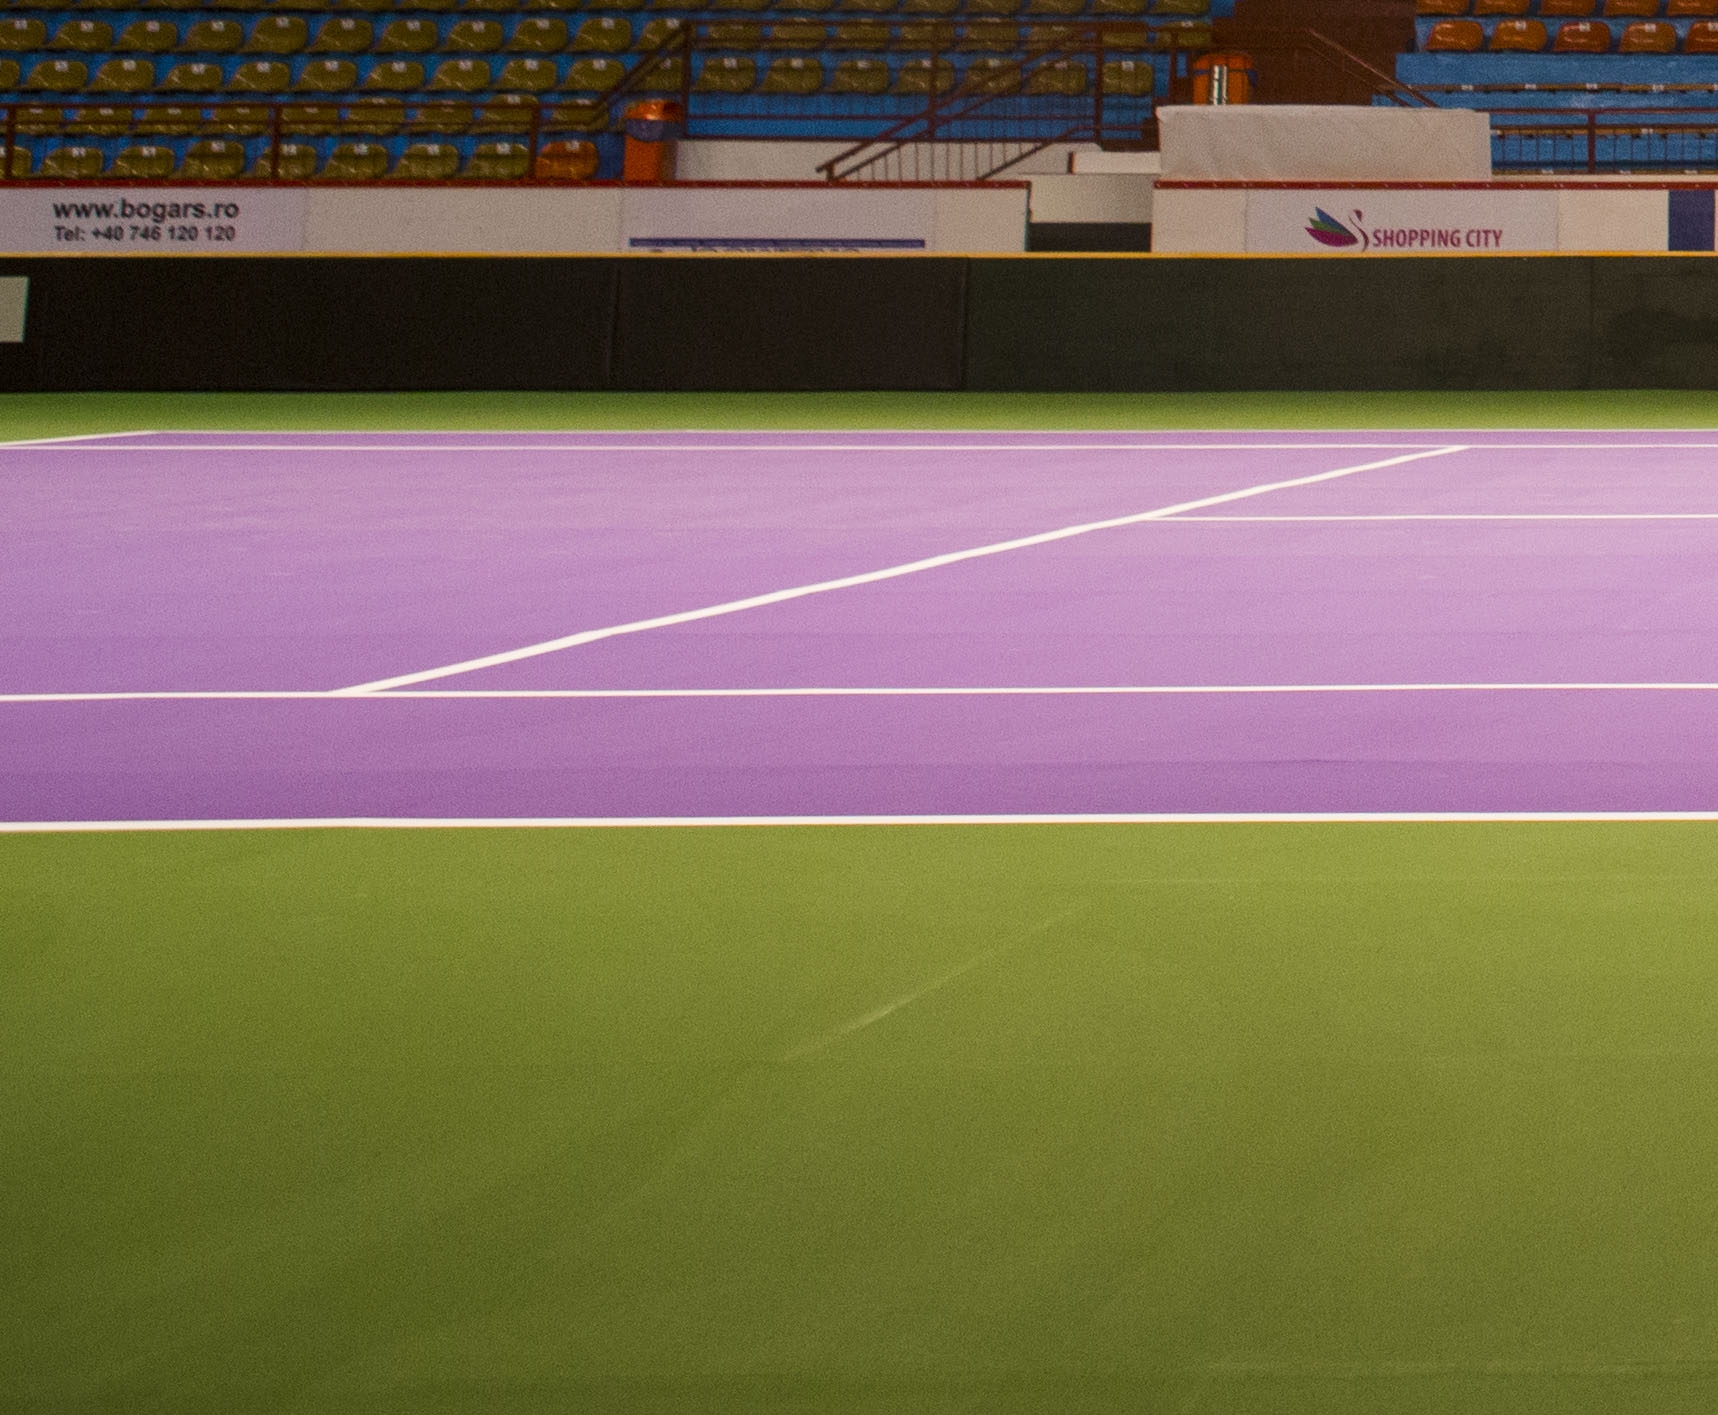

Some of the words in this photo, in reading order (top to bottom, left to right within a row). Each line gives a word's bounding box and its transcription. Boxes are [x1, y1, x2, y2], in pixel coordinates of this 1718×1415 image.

[53, 197, 240, 224] www.bogars.ro
[54, 225, 87, 241] Tel:
[91, 225, 124, 241] +40
[128, 225, 161, 241] 746
[168, 225, 199, 241] 120
[205, 225, 236, 241] 120
[1372, 228, 1461, 248] SHOPPING
[1465, 228, 1504, 248] CITY
